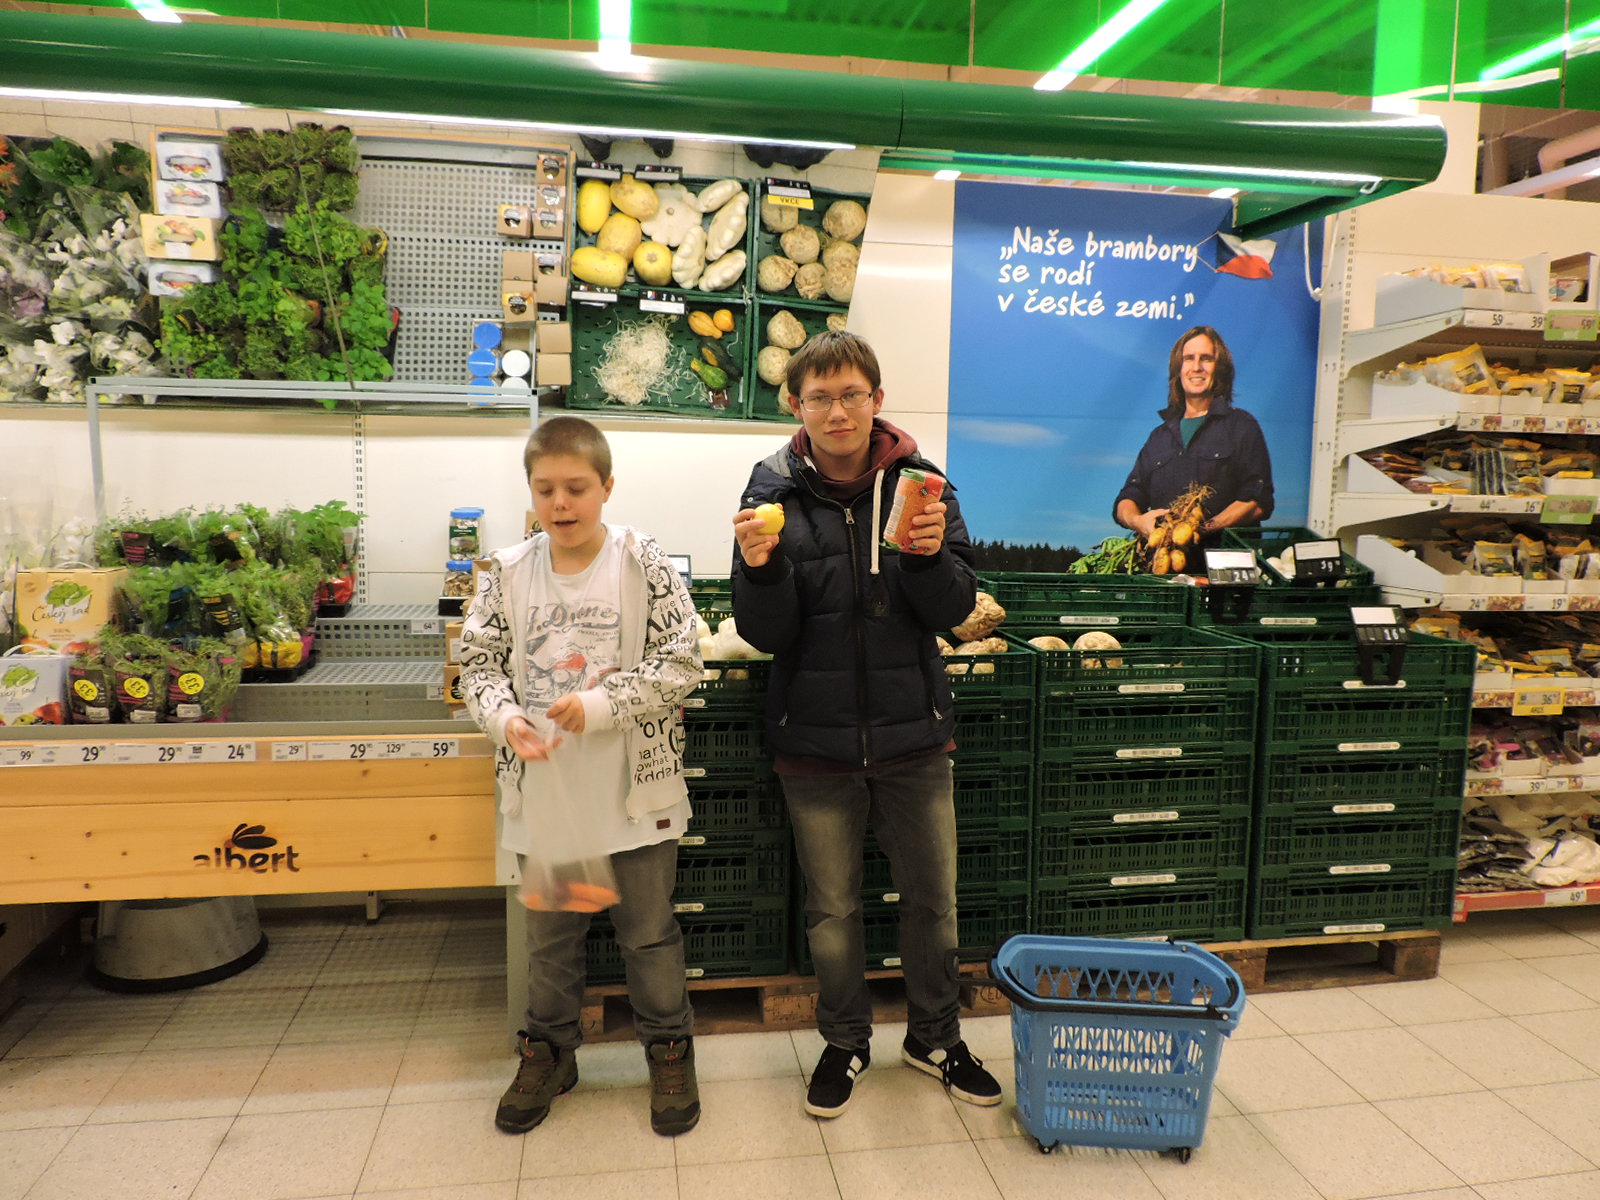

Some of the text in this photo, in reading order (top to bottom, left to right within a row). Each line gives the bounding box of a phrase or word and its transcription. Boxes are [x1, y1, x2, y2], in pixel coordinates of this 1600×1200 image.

[1085, 231, 1198, 272] brambory
[998, 259, 1095, 286] se rodí
[997, 293, 1014, 311] v
[1024, 288, 1105, 317] české
[82, 746, 99, 762] 29
[158, 746, 175, 762] 29
[227, 744, 245, 760] 24
[349, 743, 366, 759] 29
[386, 743, 401, 753] 129
[432, 742, 448, 757] 59
